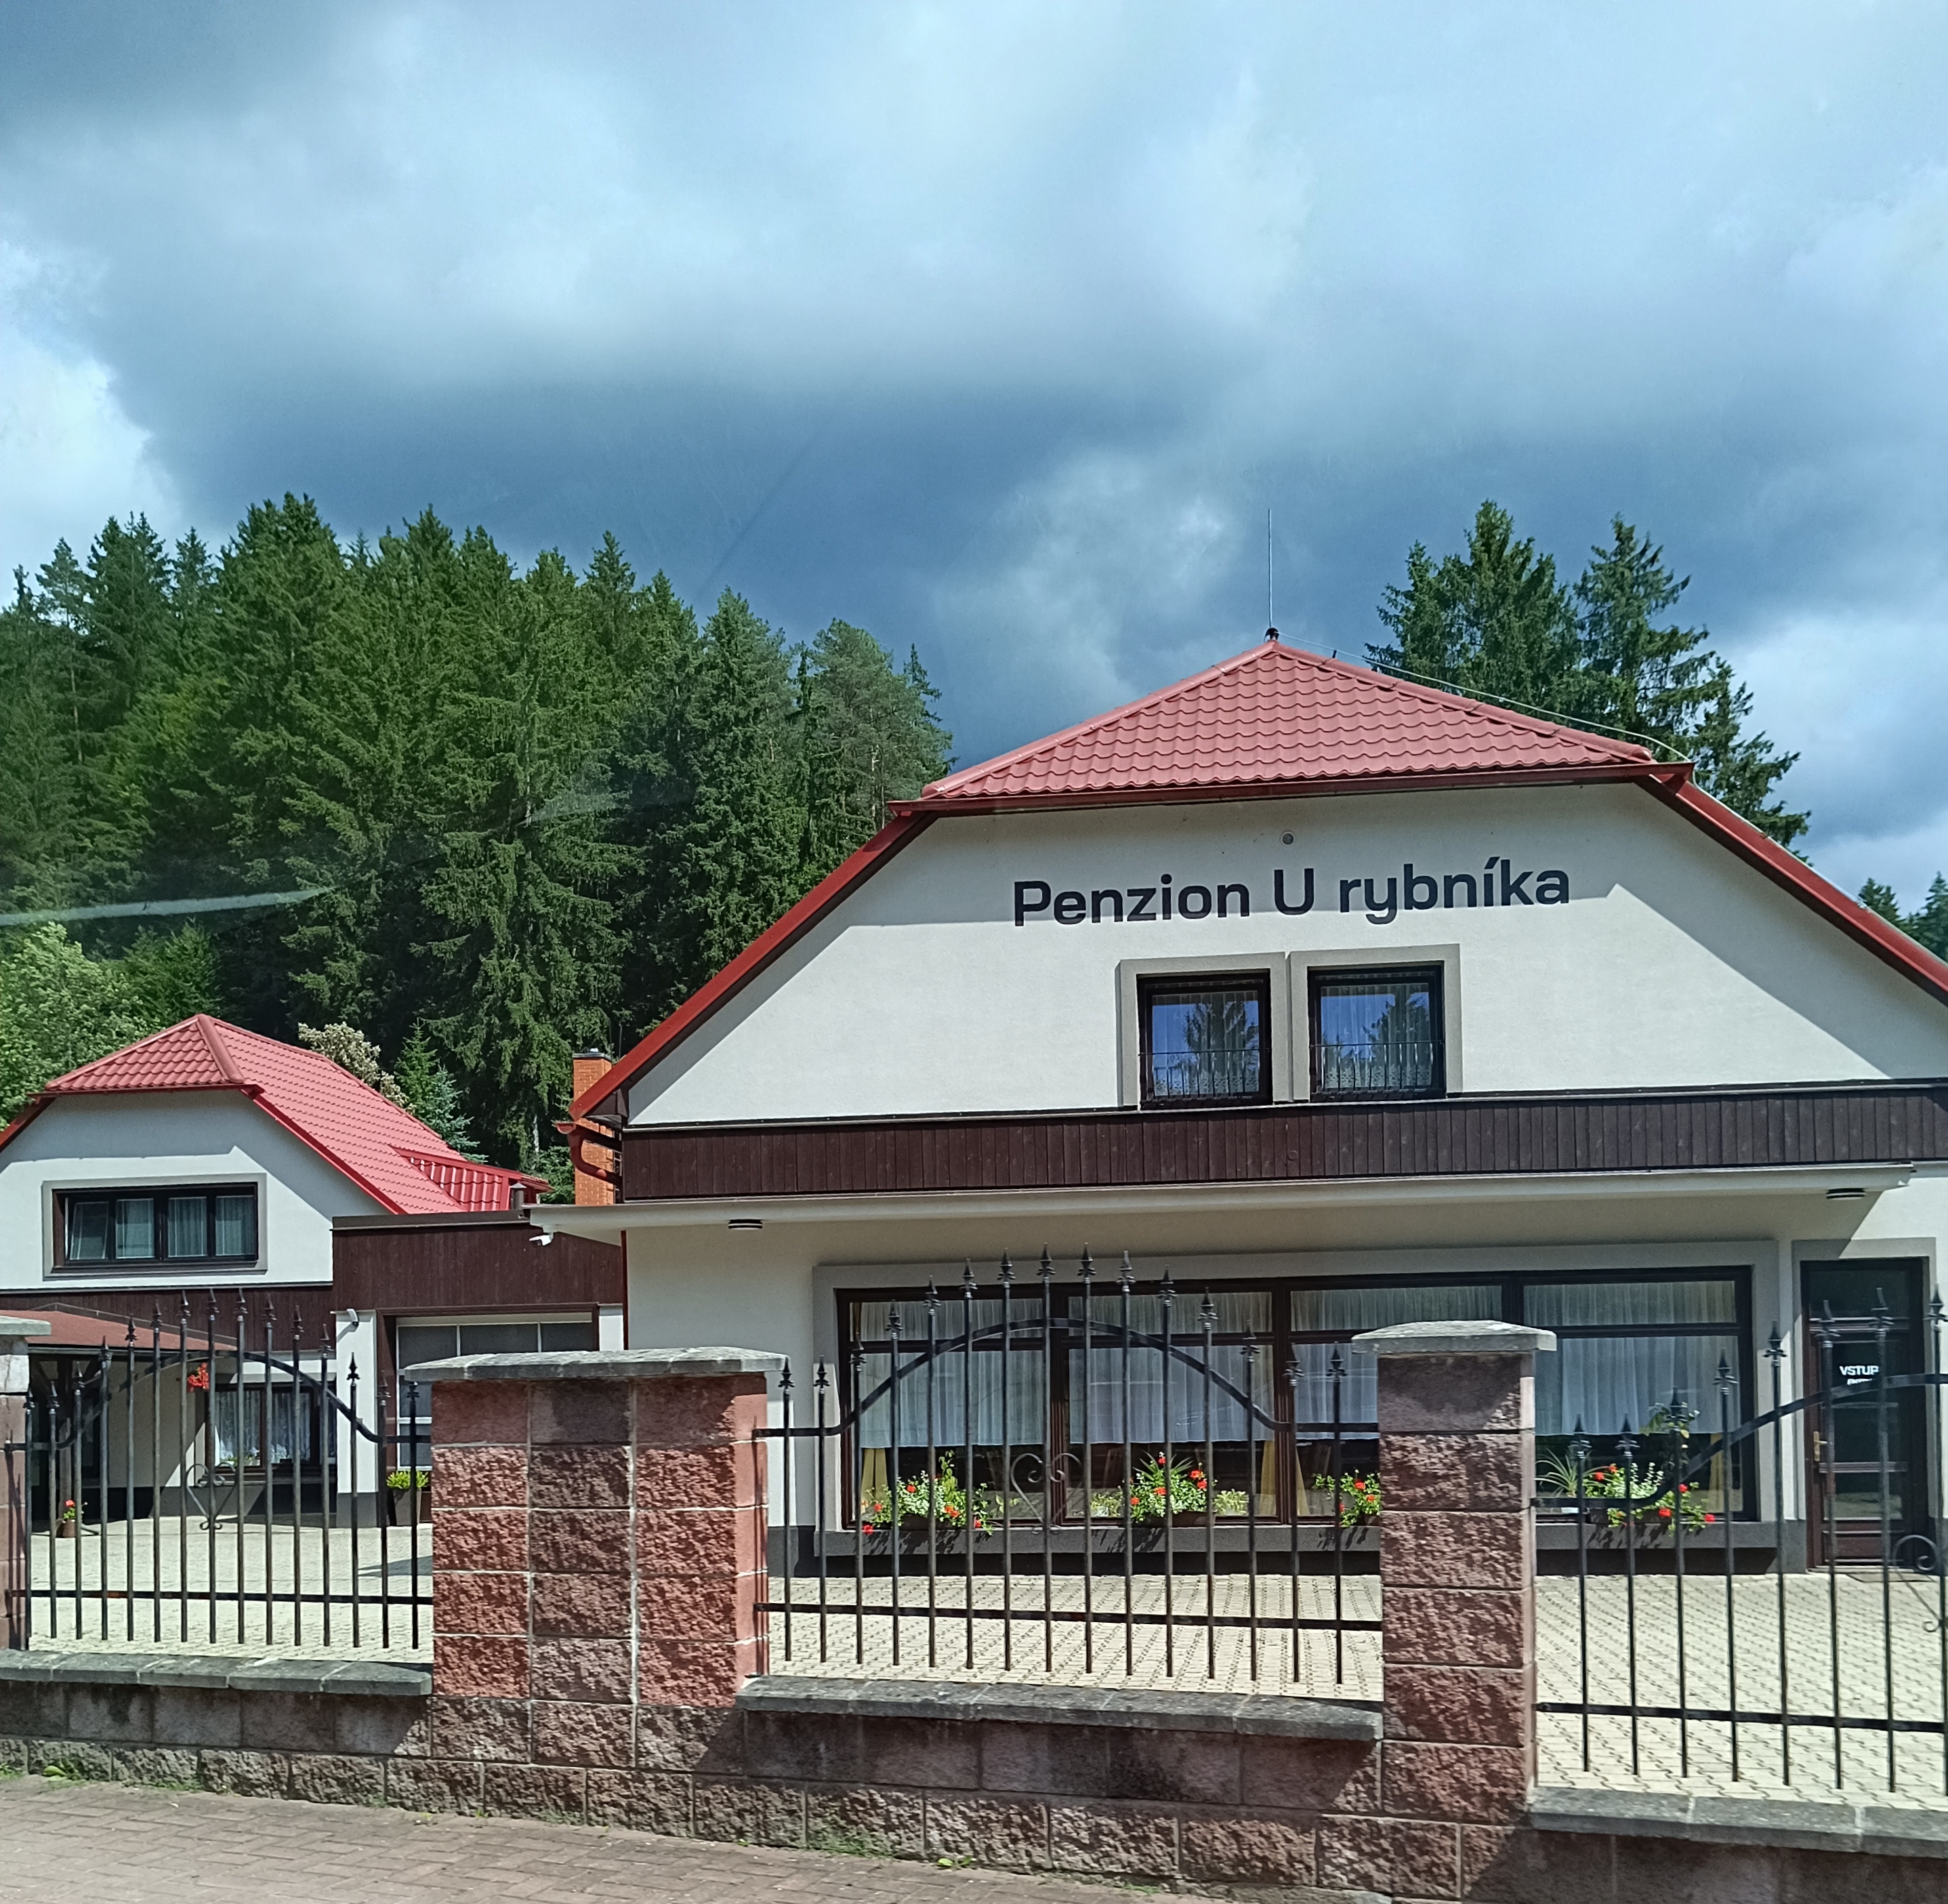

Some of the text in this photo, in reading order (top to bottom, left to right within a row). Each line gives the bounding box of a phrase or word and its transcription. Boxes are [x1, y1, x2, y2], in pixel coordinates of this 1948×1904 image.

[1014, 856, 1570, 926] Penzion U rybníka
[1839, 1365, 1879, 1376] VSTUP
